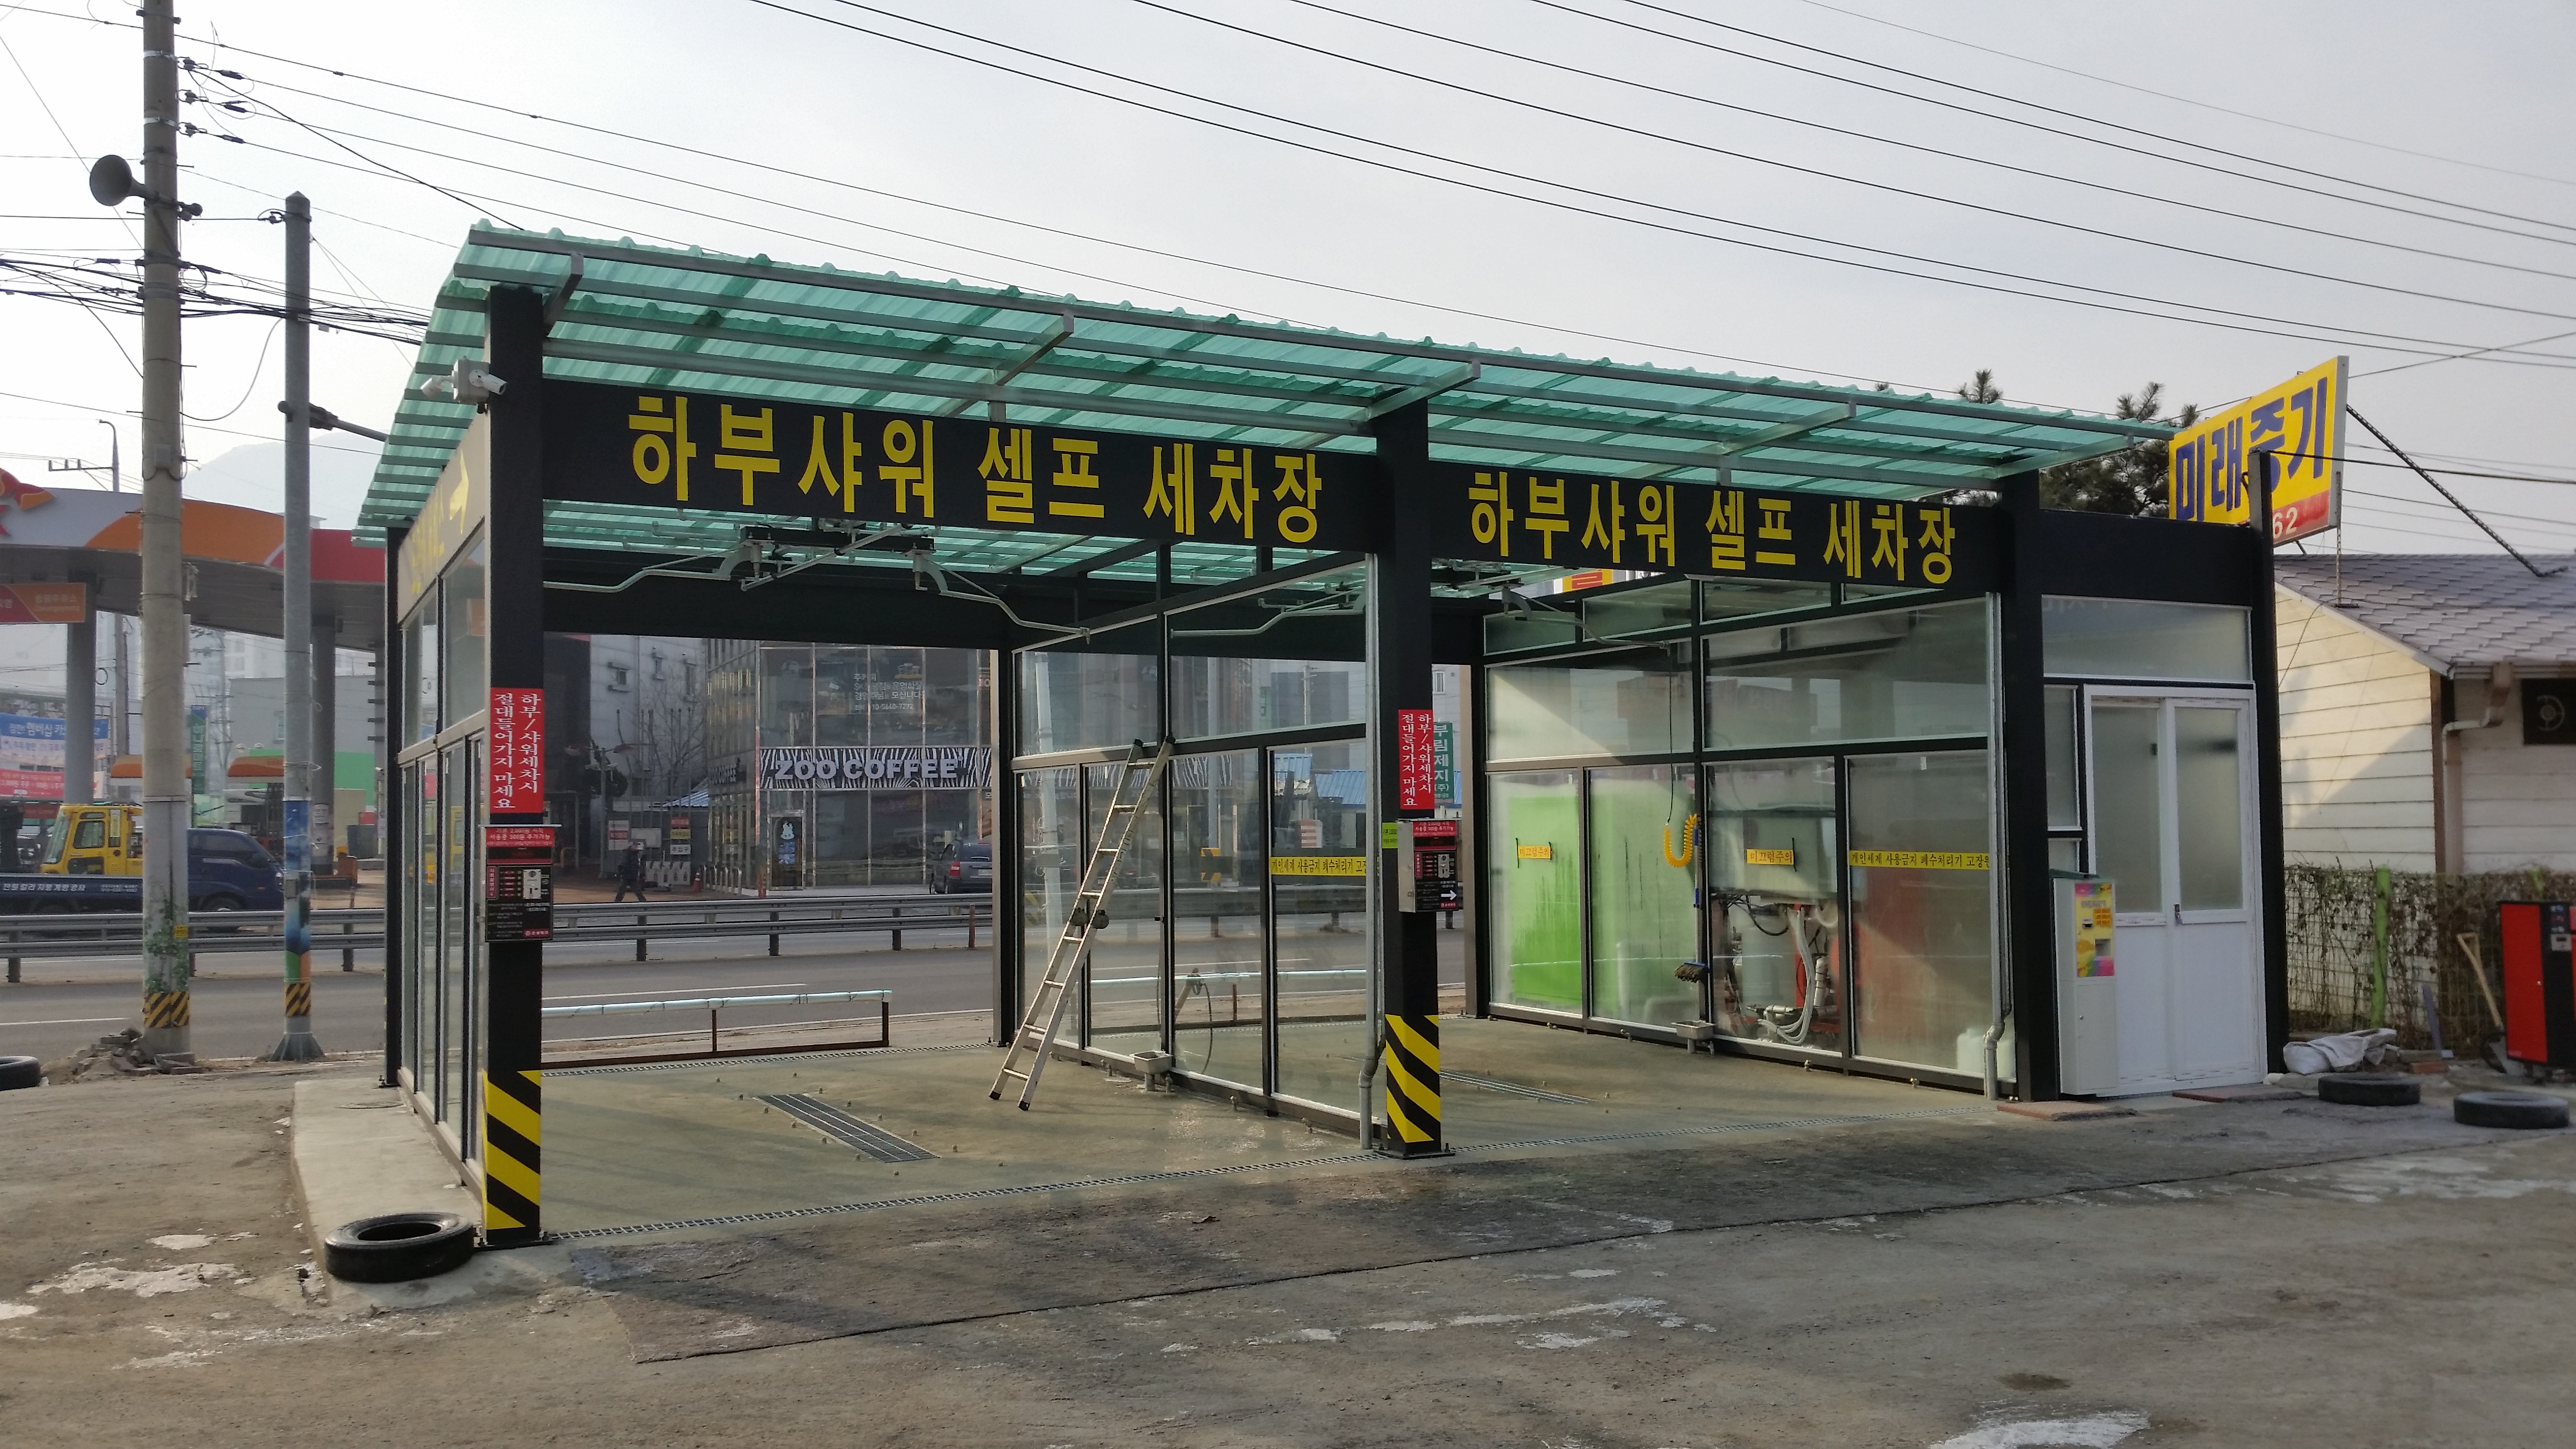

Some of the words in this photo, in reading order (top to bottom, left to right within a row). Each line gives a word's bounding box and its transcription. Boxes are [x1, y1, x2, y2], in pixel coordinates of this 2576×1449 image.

[2176, 377, 2327, 522] 미래중기
[629, 396, 934, 518] 하부샤워
[978, 427, 1105, 524] 셀프
[1144, 442, 1321, 544] 세차장
[1468, 471, 1675, 566] 하부샤워
[1706, 489, 1796, 570] 셀프
[1824, 500, 1955, 584] 세차장
[1417, 714, 1433, 793] 하부/샤워세차시
[775, 759, 837, 779] ZOO
[844, 759, 957, 779] COFFEE
[1519, 847, 1549, 857] 미끄럼주의
[1751, 850, 1792, 863] 미끄럼주의
[1885, 853, 1916, 866] 사용금지
[1297, 858, 1320, 873] 사용금지
